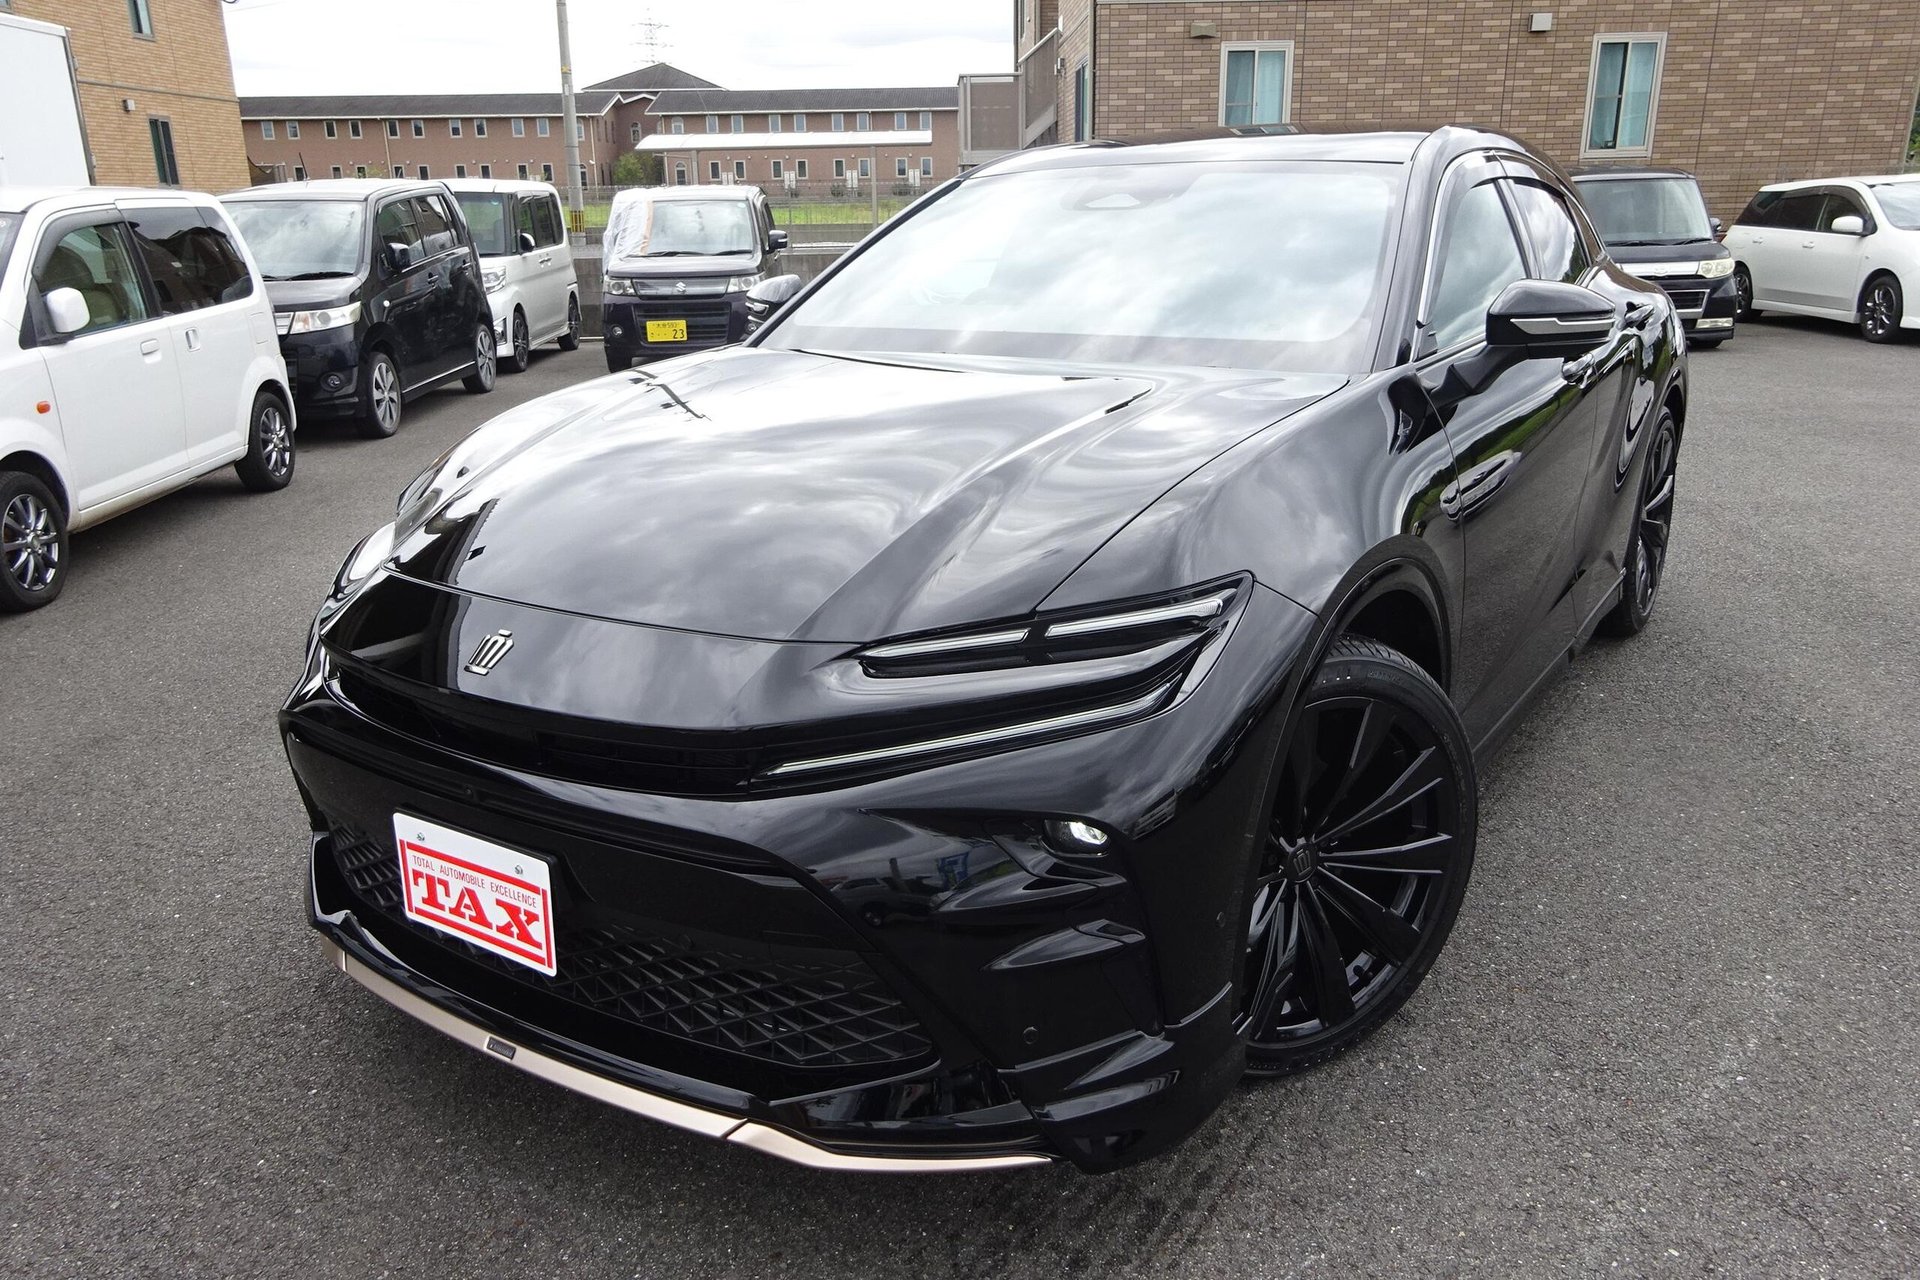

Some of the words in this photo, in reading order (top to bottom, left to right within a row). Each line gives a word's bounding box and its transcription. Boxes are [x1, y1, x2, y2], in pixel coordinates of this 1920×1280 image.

[412, 868, 543, 951] TAX
[413, 855, 435, 871] TOTAL
[440, 865, 486, 889] AUTOMOBILE
[490, 882, 537, 909] EXCELLENCE
